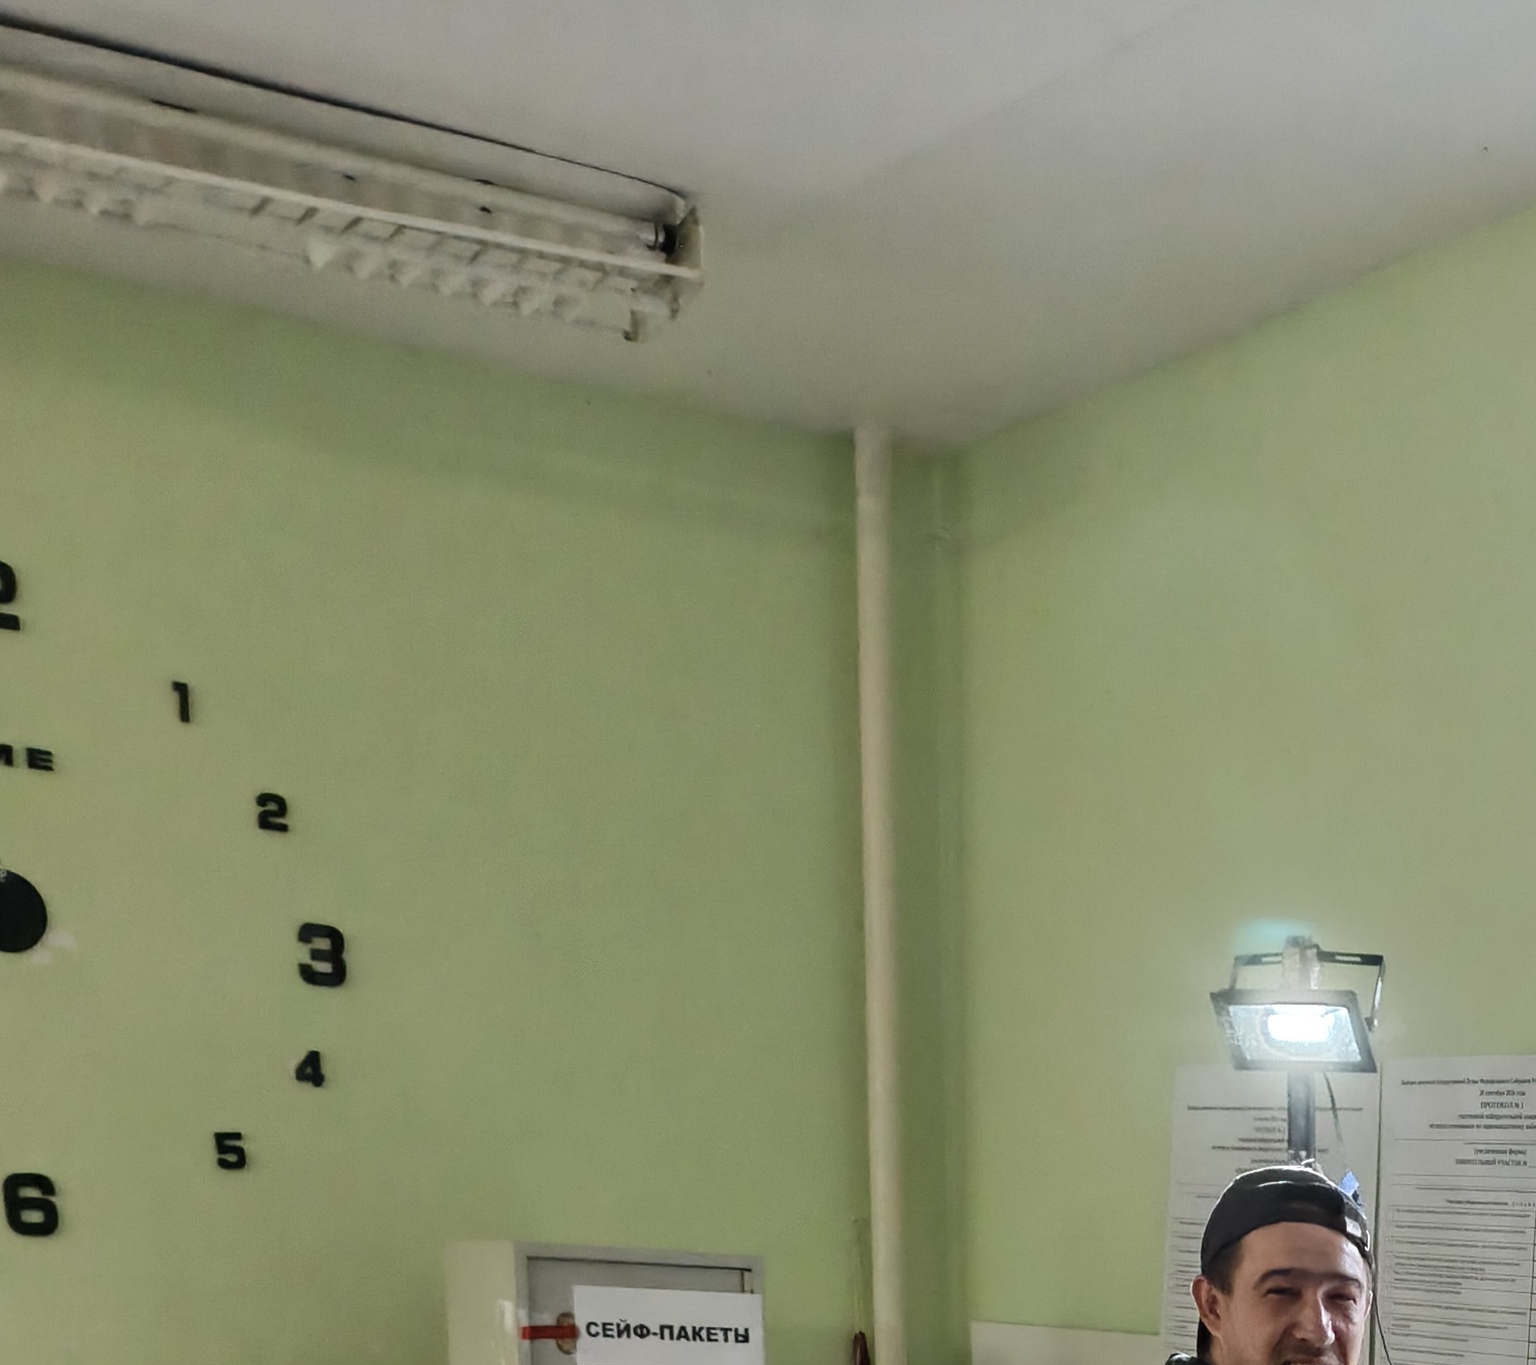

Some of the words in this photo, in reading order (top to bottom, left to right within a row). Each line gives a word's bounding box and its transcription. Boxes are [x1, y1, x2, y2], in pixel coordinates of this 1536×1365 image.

[171, 680, 191, 724] 1
[255, 792, 290, 832] 2
[297, 922, 347, 987] 3
[295, 1050, 325, 1087] 4
[214, 1132, 247, 1170] 5
[2, 1172, 59, 1237] 6
[585, 1318, 750, 1344] СЕЙФ-ПАКЕТЫ
